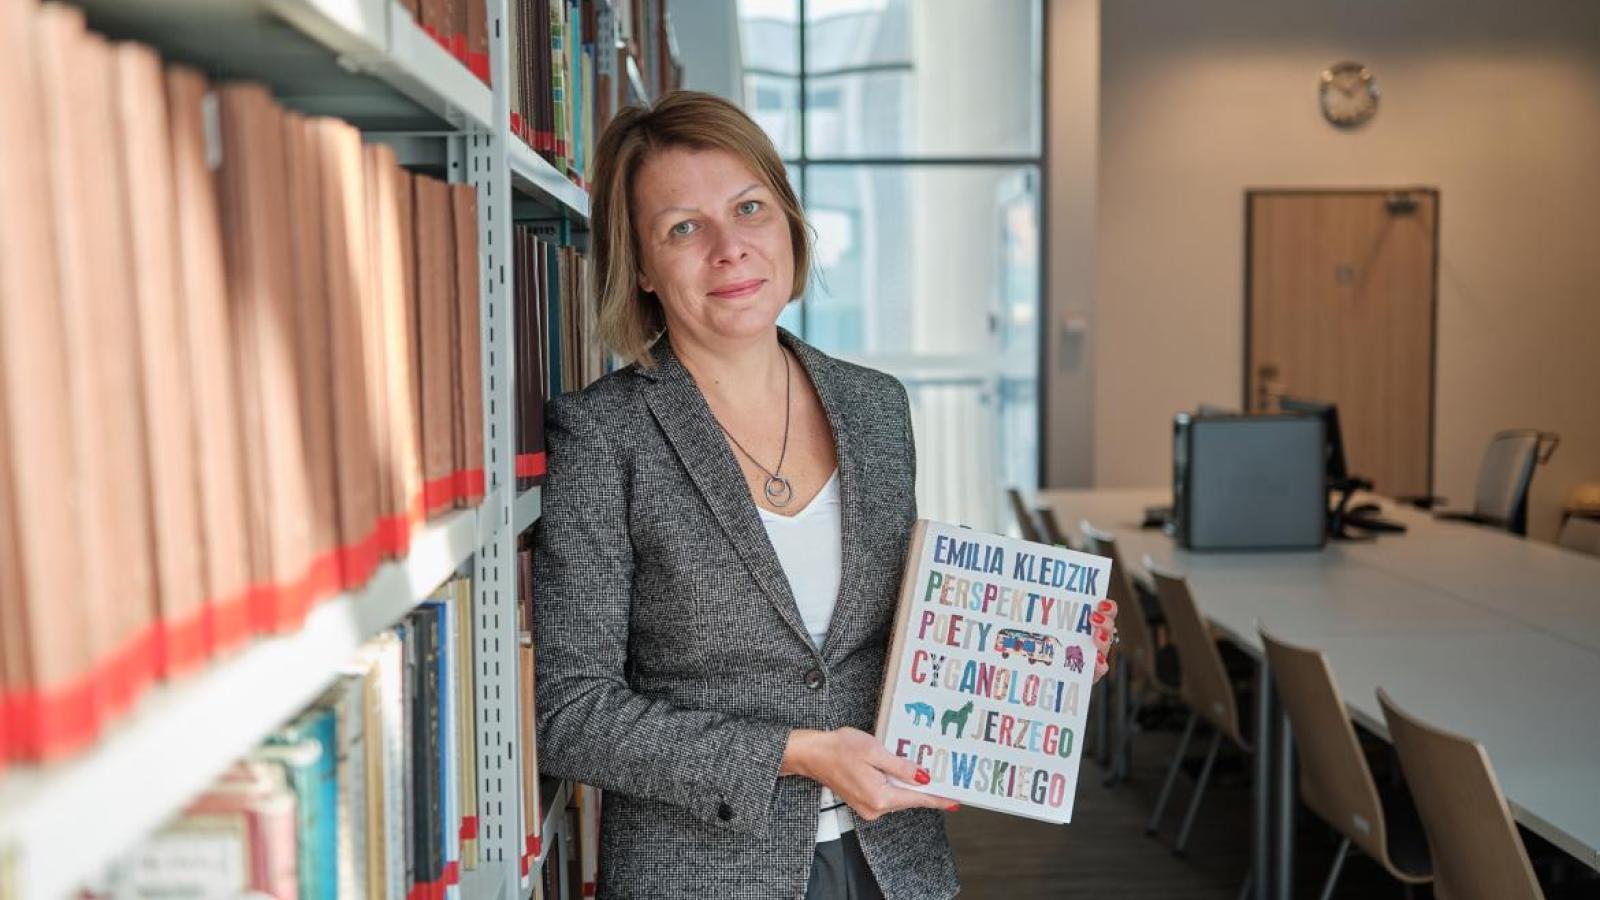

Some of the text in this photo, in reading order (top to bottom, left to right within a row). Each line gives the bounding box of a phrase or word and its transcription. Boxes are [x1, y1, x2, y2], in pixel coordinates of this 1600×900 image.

[933, 535, 1100, 596] EMILIA KLEDZIK
[918, 610, 992, 653] POETY
[924, 569, 1092, 636] PERSPEKTYWA
[911, 650, 1080, 716] CYGANOLOGIA
[971, 711, 1074, 759] JERZEGO
